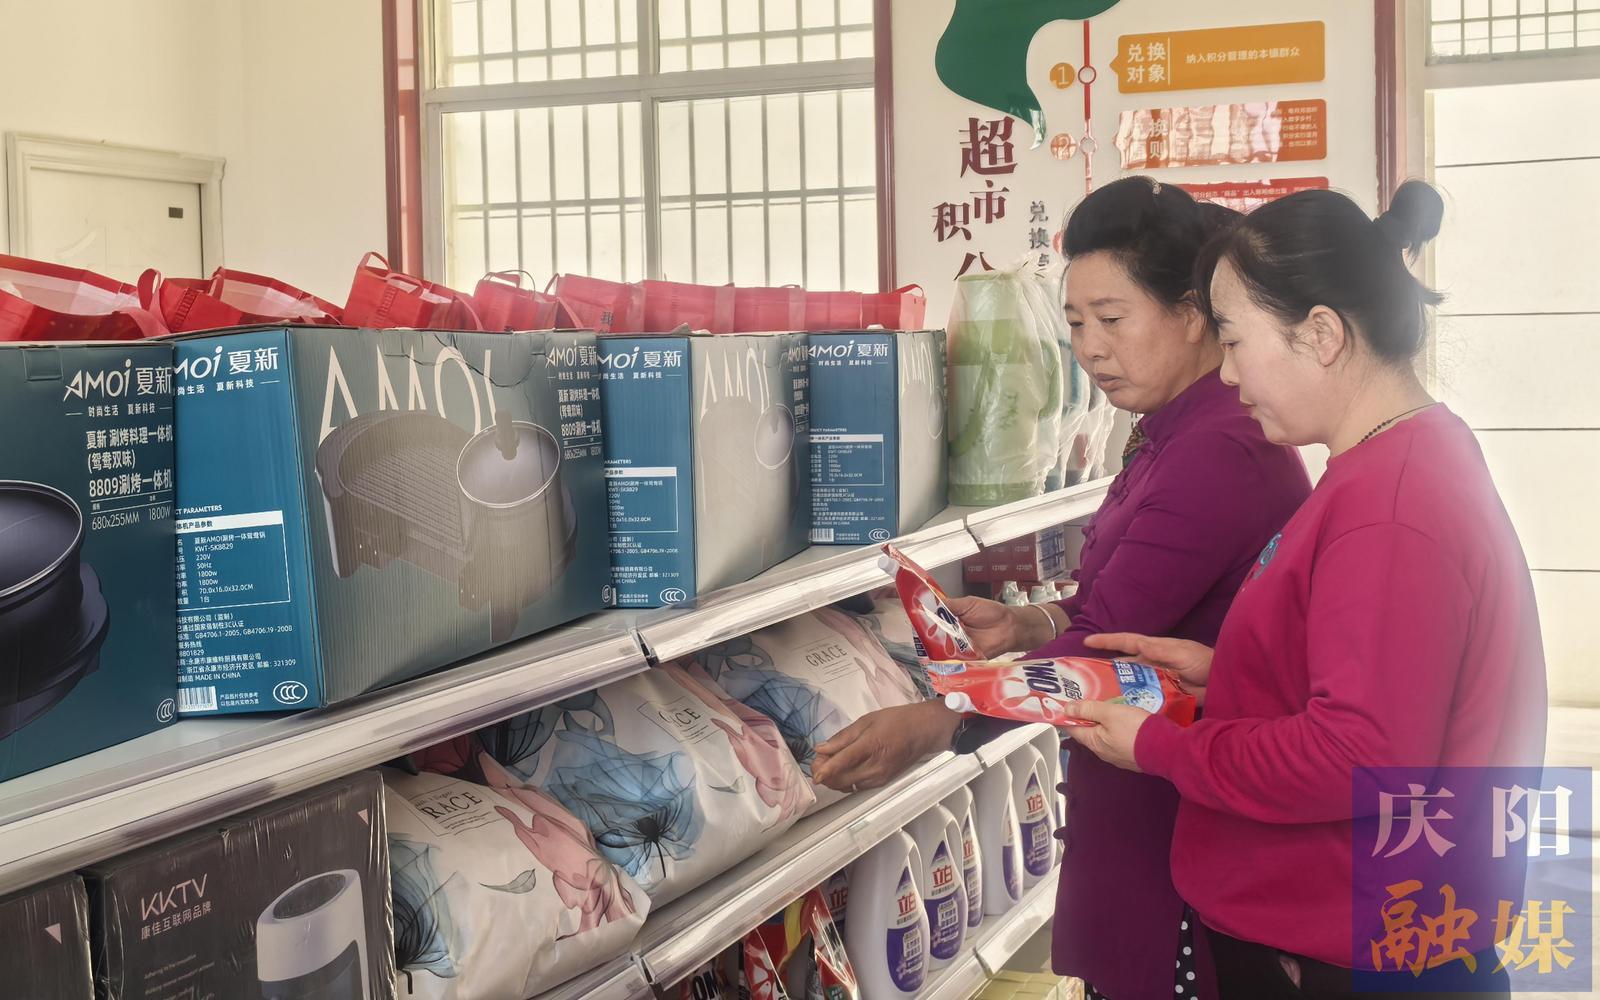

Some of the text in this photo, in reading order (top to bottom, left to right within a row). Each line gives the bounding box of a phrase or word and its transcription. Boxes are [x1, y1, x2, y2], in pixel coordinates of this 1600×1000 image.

[1126, 42, 1168, 64] 兑换
[1056, 66, 1070, 86] 1
[1126, 63, 1167, 84] 对象
[227, 346, 279, 375] 夏新
[578, 345, 598, 366] 夏新
[643, 350, 682, 369] 夏新
[857, 343, 889, 357] 夏新
[135, 367, 173, 396] 夏新
[602, 371, 662, 380] 尚生活 夏新科技
[177, 379, 255, 396] 尚生活 夏新科技
[88, 403, 156, 418] 时尚生活 夏新科技
[86, 424, 173, 450] 夏新 涮烤料理一体机
[89, 469, 172, 498] 8809涮烤一体机
[92, 506, 171, 531] 680x255MM 1800W
[183, 504, 223, 514] PARAMETERS
[176, 520, 213, 530] 体机产品参数
[805, 644, 848, 668] GRACE
[195, 673, 213, 681] MADE
[213, 672, 221, 680] IN
[221, 671, 241, 679] CHINA
[417, 791, 483, 820] RACE
[140, 873, 208, 921] KKTV
[140, 901, 212, 941] 康佳互联网品牌
